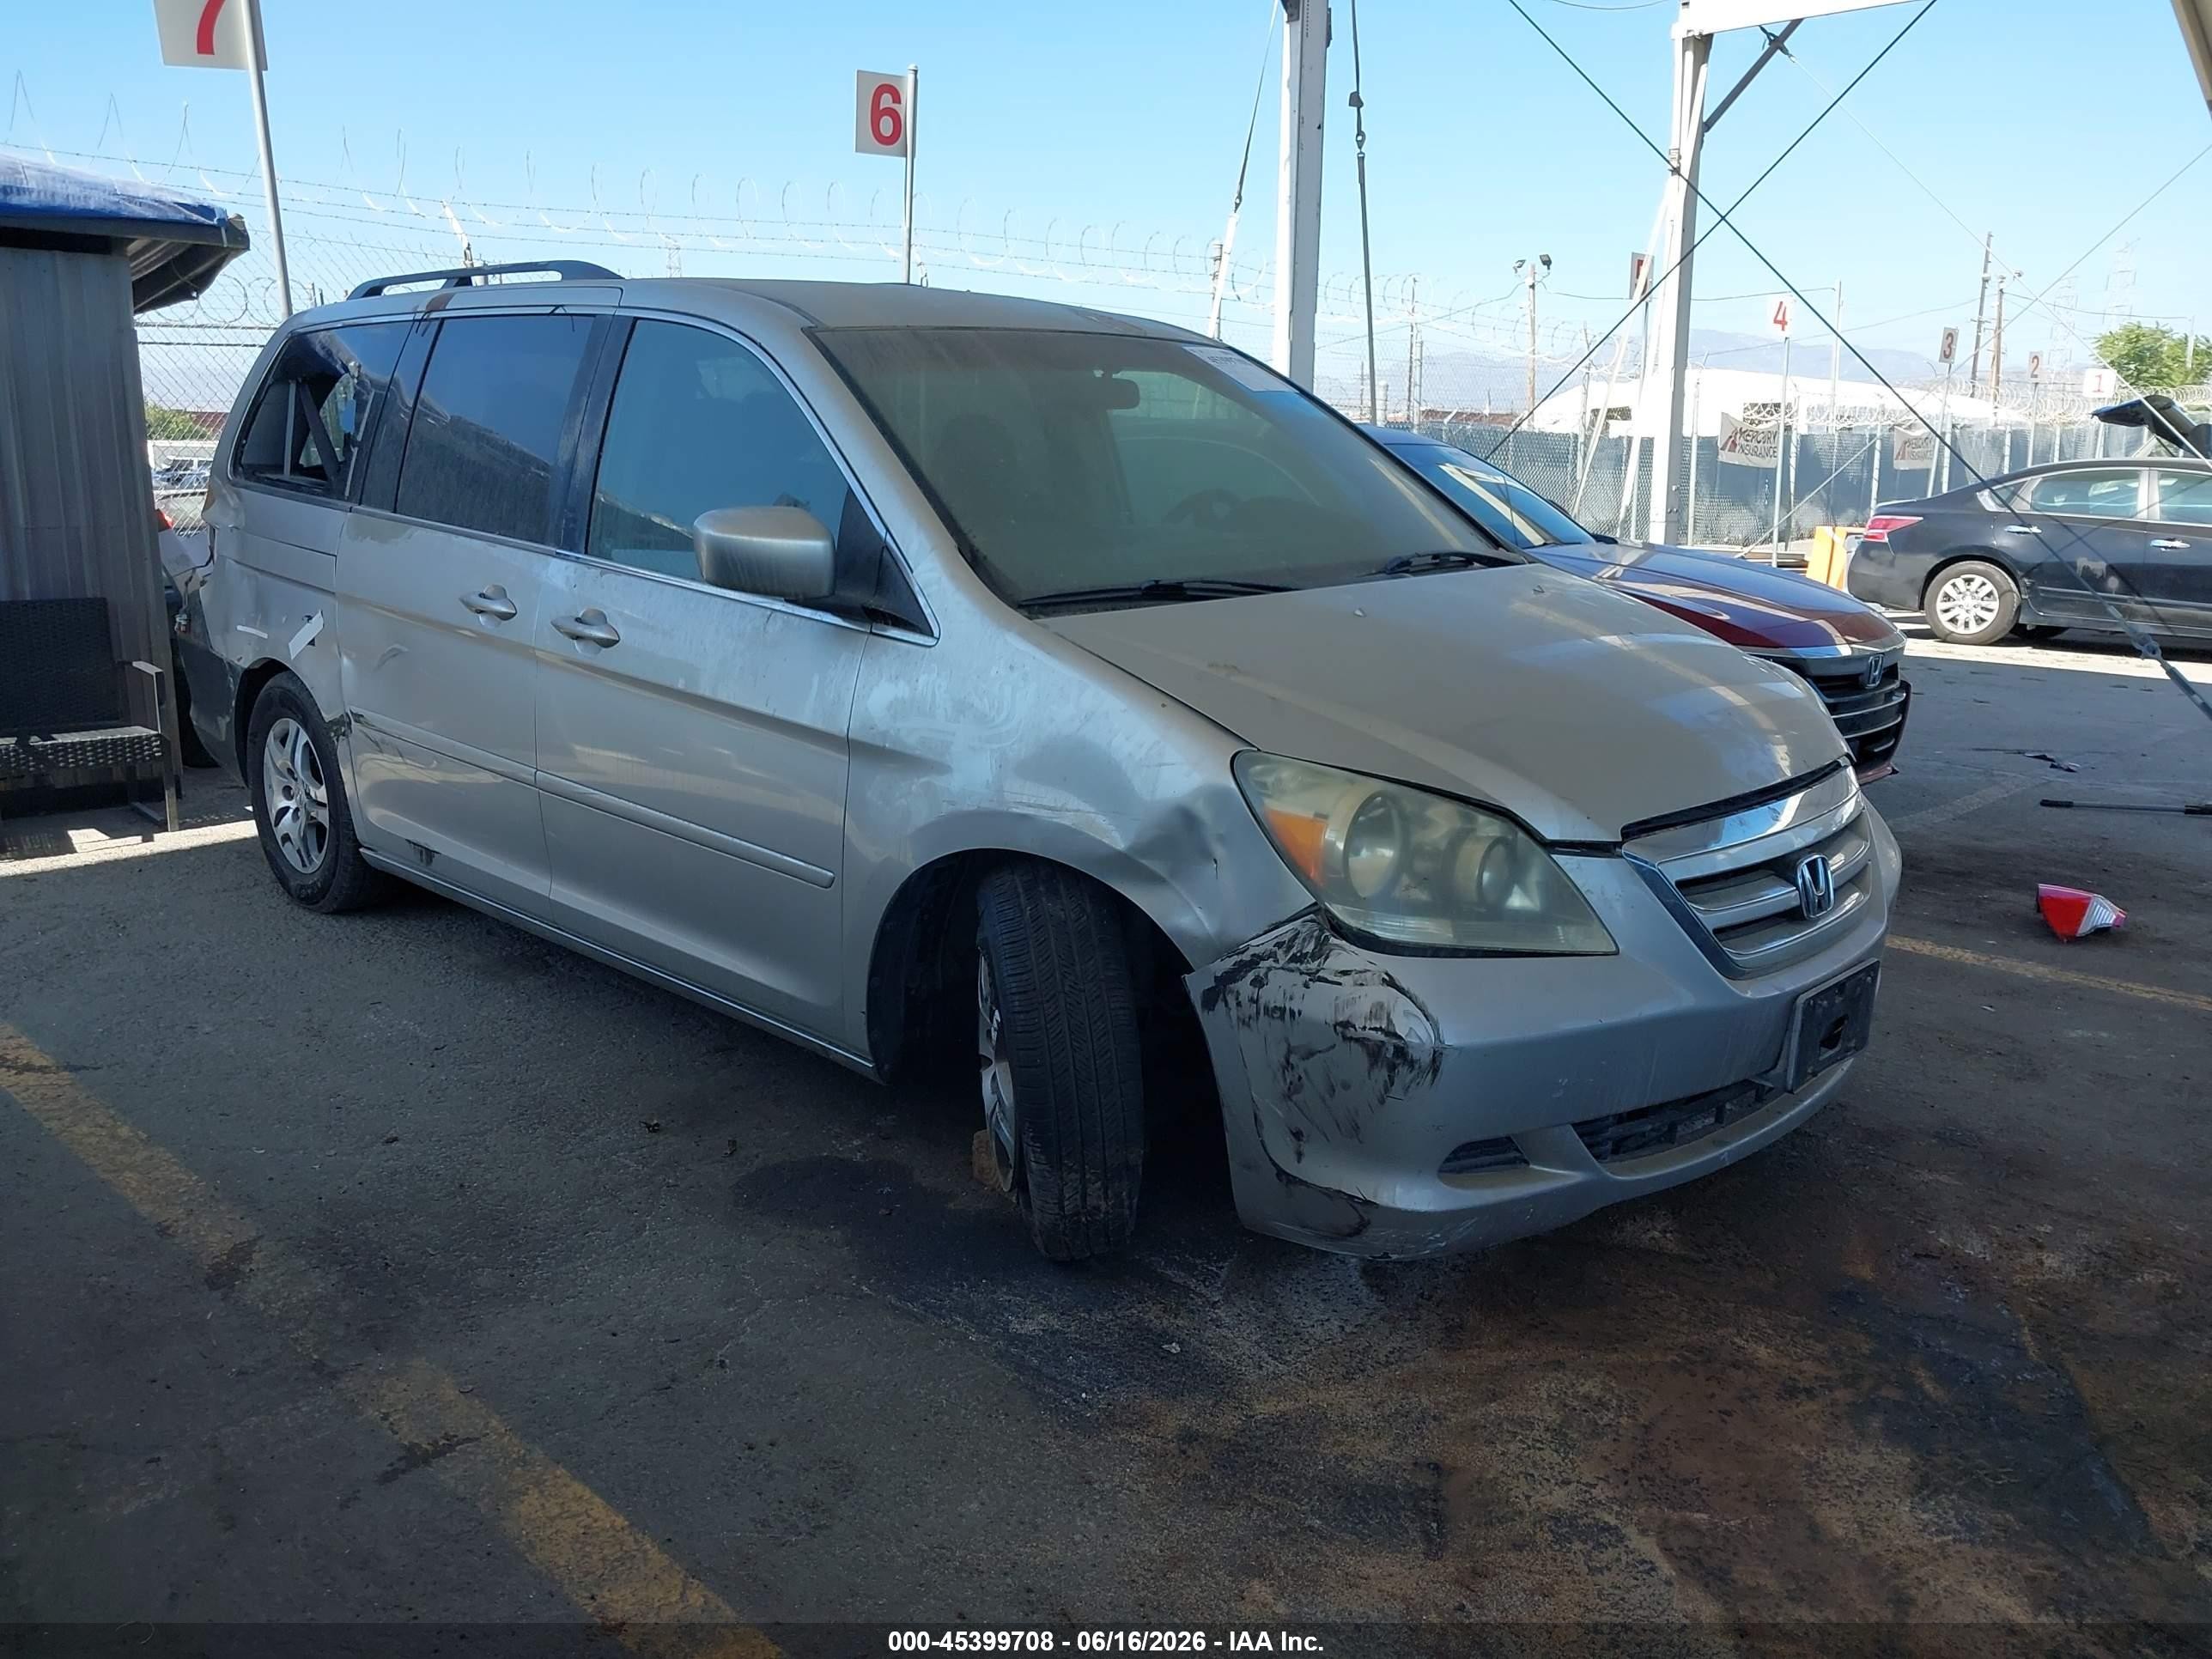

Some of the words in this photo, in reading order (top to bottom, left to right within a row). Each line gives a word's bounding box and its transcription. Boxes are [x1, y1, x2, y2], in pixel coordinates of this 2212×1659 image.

[870, 82, 902, 147] 6
[1773, 301, 1788, 331] 4
[1943, 332, 1954, 359] 3
[2030, 355, 2039, 379] 2
[2092, 373, 2104, 393] 1
